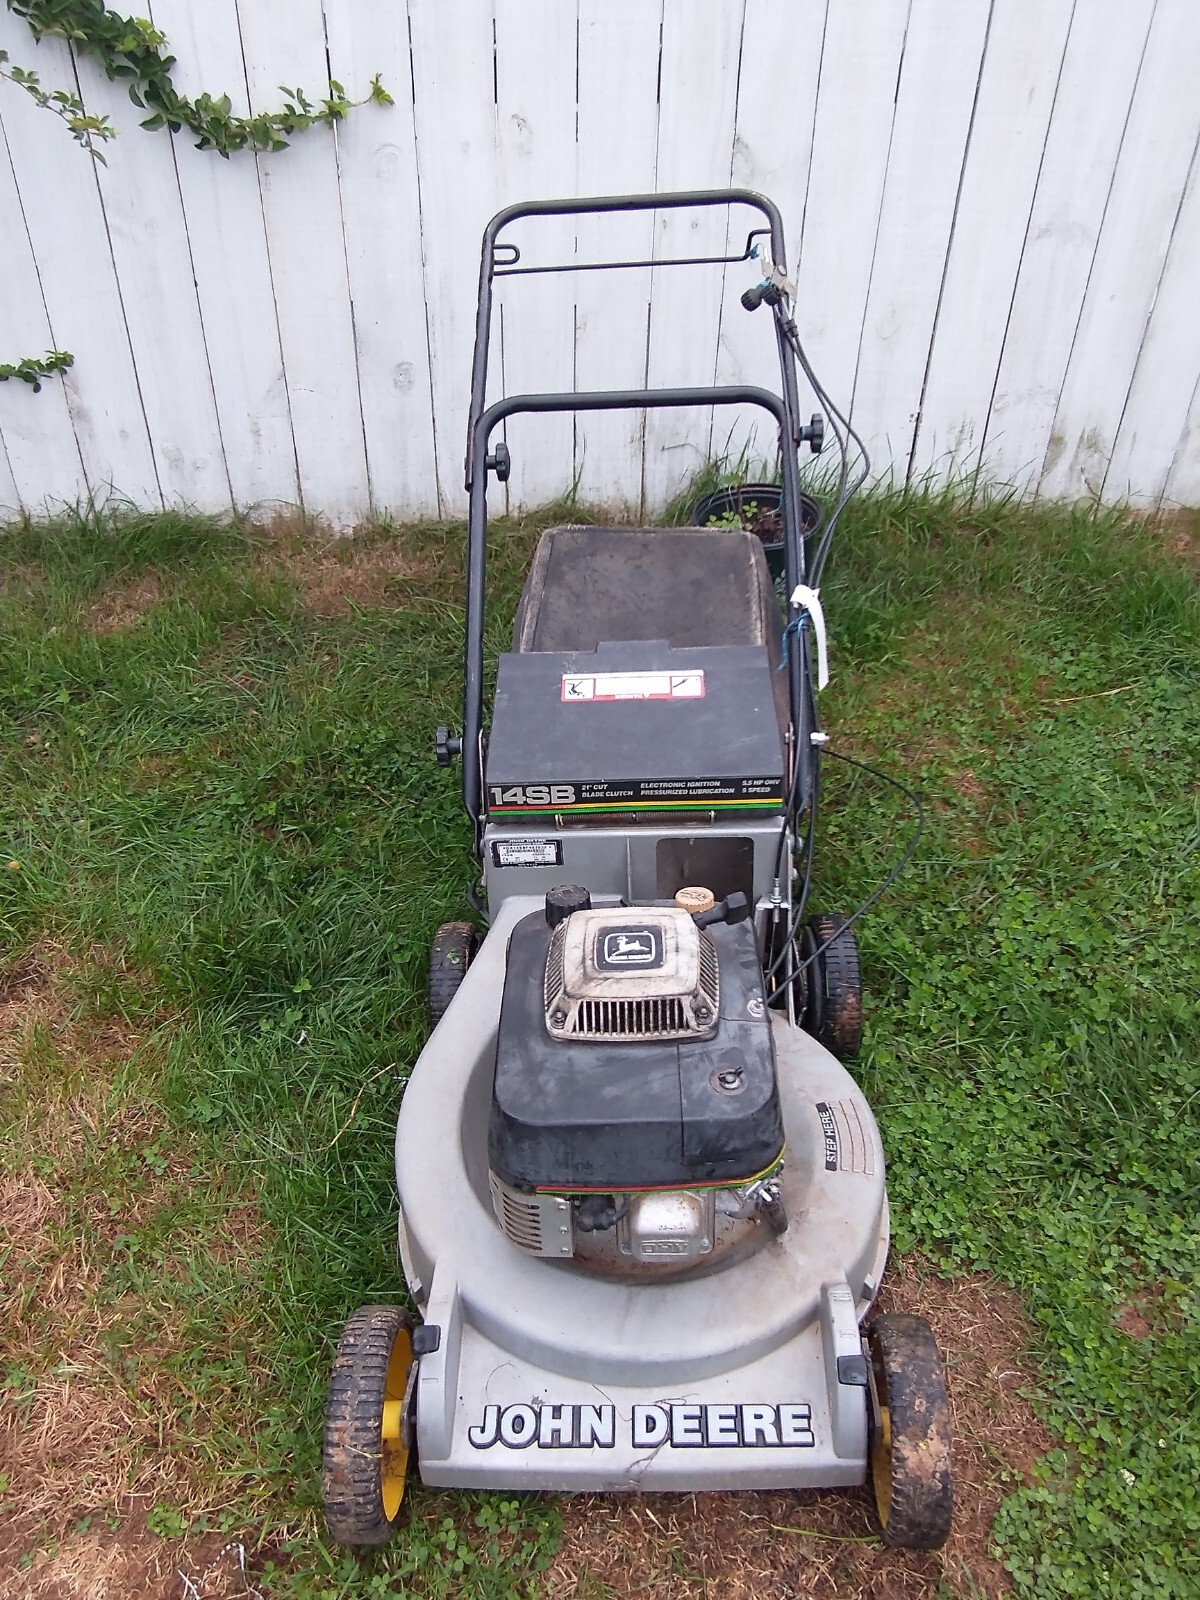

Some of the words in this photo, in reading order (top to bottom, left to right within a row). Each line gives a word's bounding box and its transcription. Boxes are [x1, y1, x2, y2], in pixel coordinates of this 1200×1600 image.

[490, 785, 576, 805] 14SB
[640, 788, 688, 796] PRESSURIZED
[689, 787, 735, 795] LUBRICATION
[819, 1110, 836, 1136] HERE
[826, 1138, 837, 1163] STEP
[468, 1403, 616, 1449] JOHN
[632, 1403, 816, 1449] DEERE
